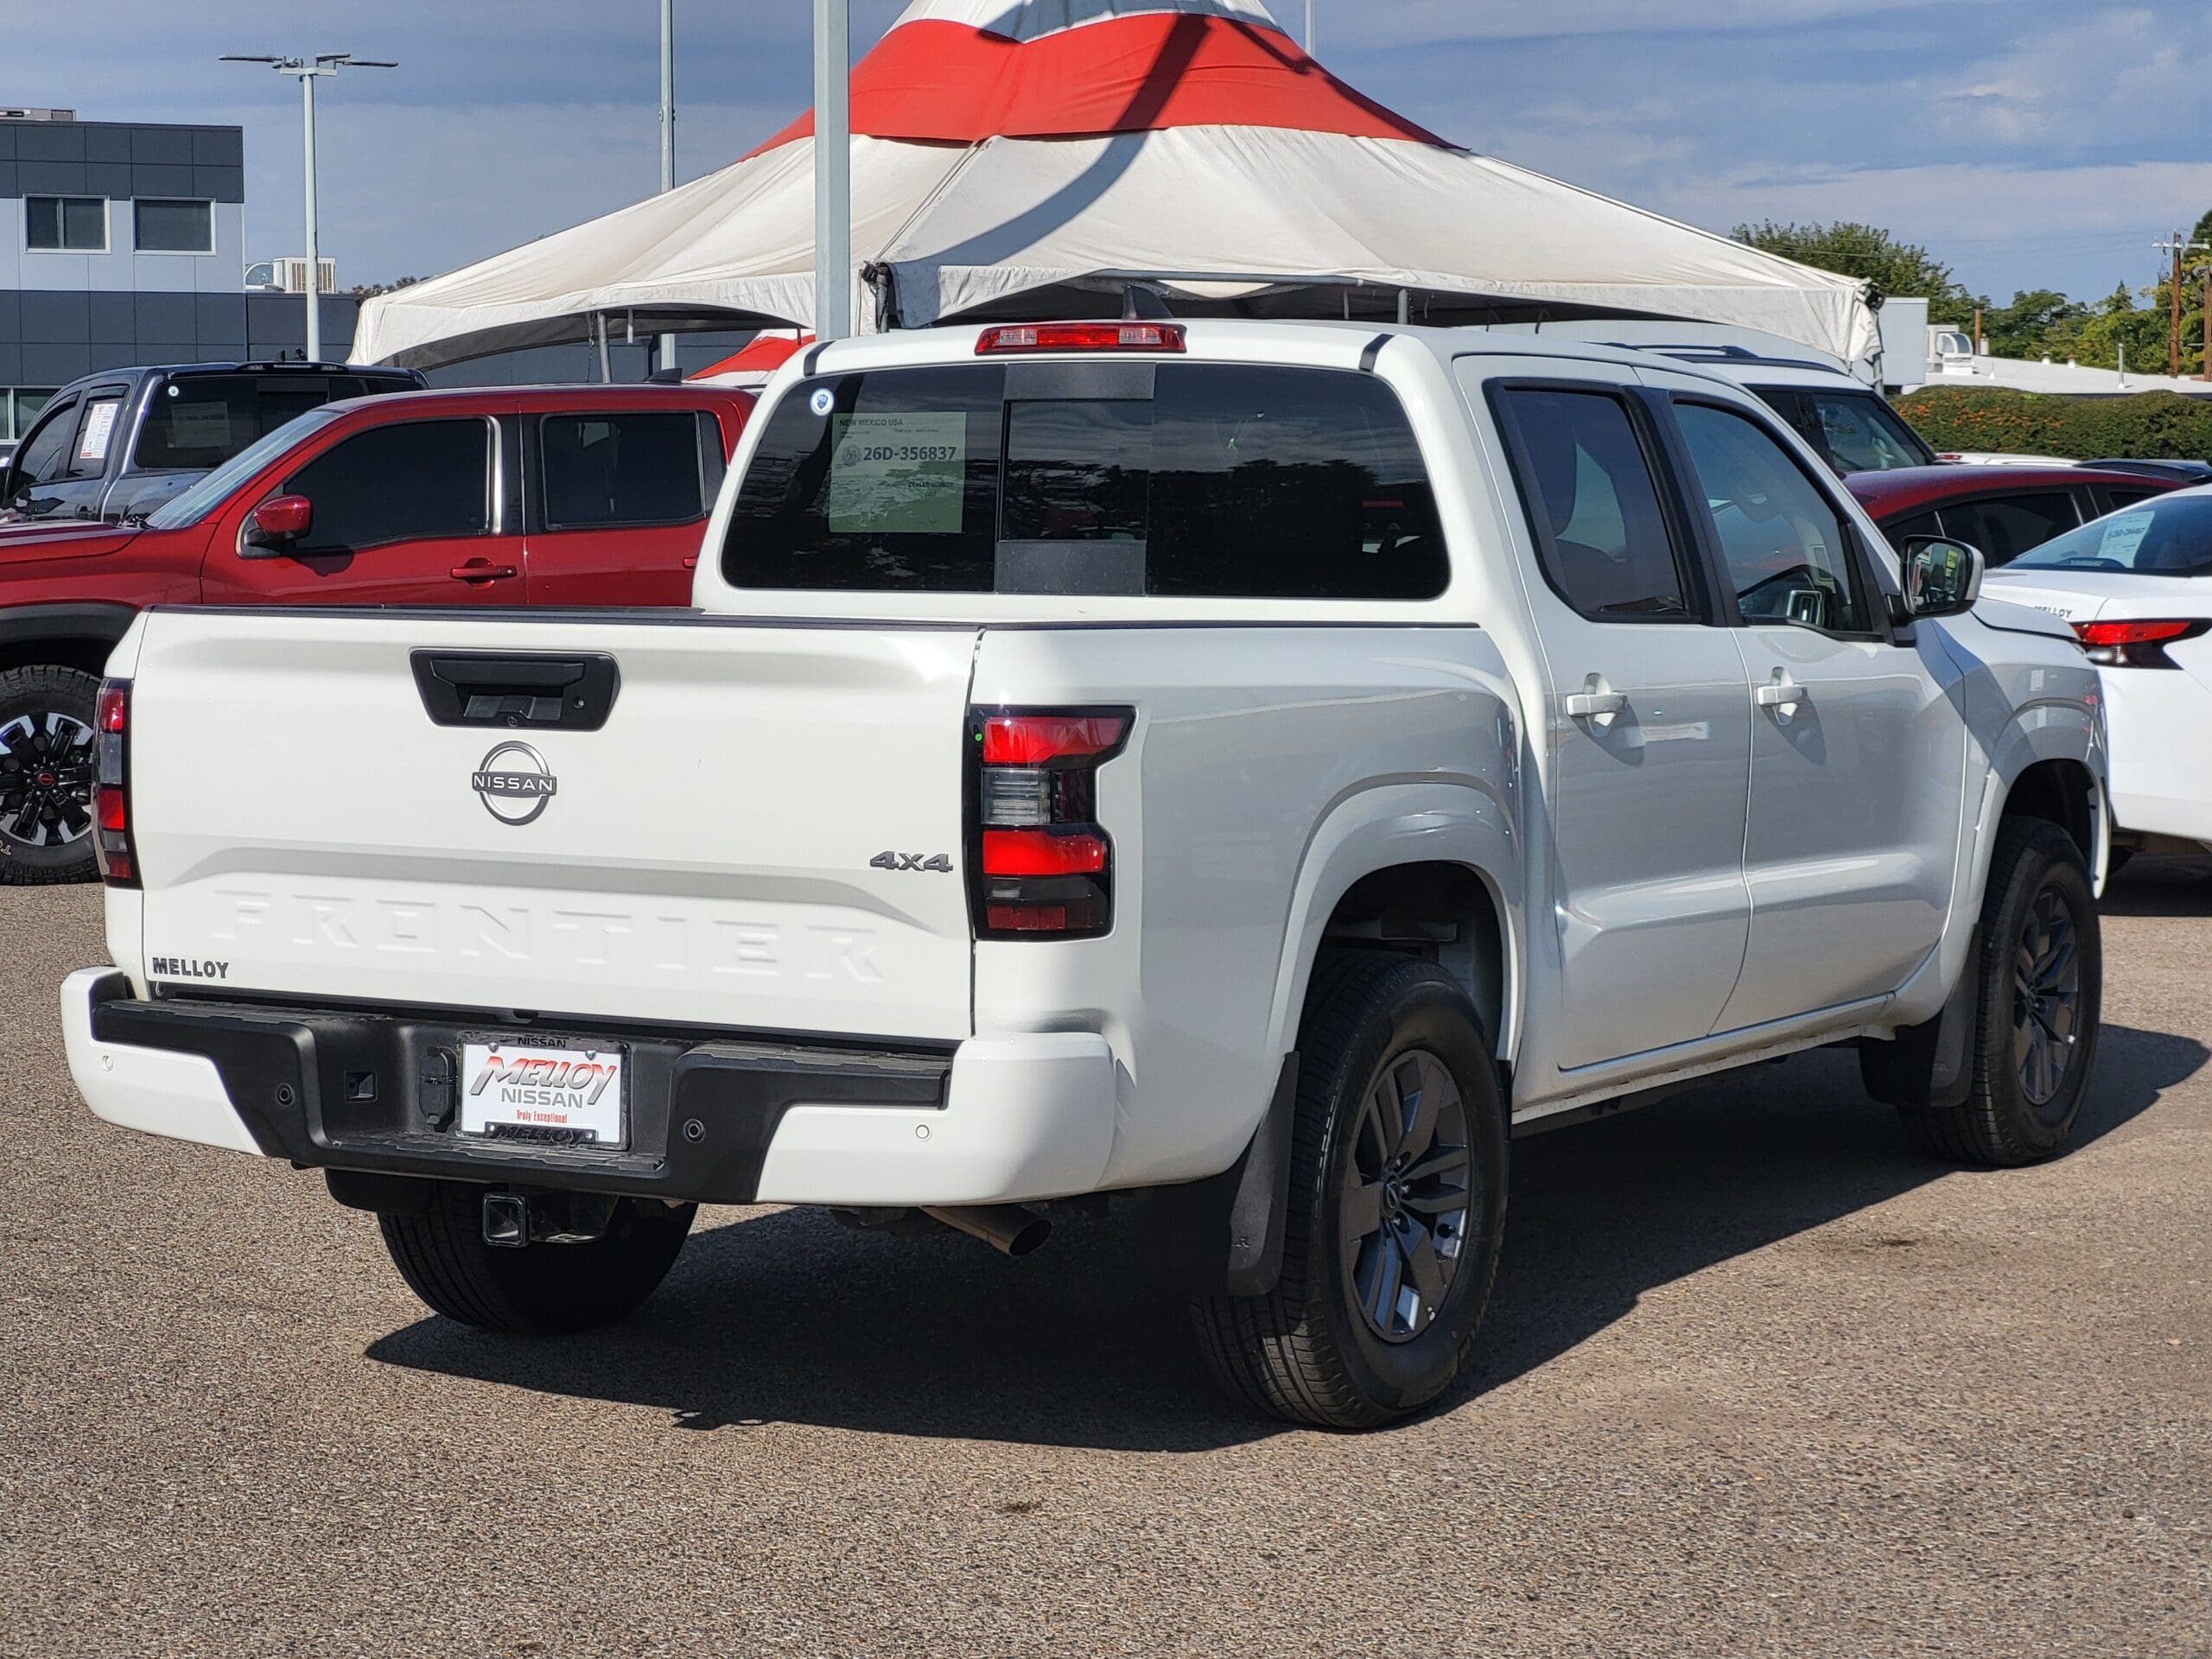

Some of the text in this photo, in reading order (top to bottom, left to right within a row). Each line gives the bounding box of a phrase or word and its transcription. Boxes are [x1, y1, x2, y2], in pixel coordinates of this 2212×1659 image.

[863, 446, 957, 461] 26D-356837
[473, 774, 553, 791] NISSAN
[212, 889, 884, 983] FRONTIER
[152, 957, 229, 979] MELLOY
[518, 1037, 566, 1049] NISSAN
[469, 1056, 617, 1105] MELLOY
[501, 1088, 582, 1109] NISSAN
[516, 1109, 568, 1123] Truly Exceptional
[491, 1125, 584, 1145] MELLOY
